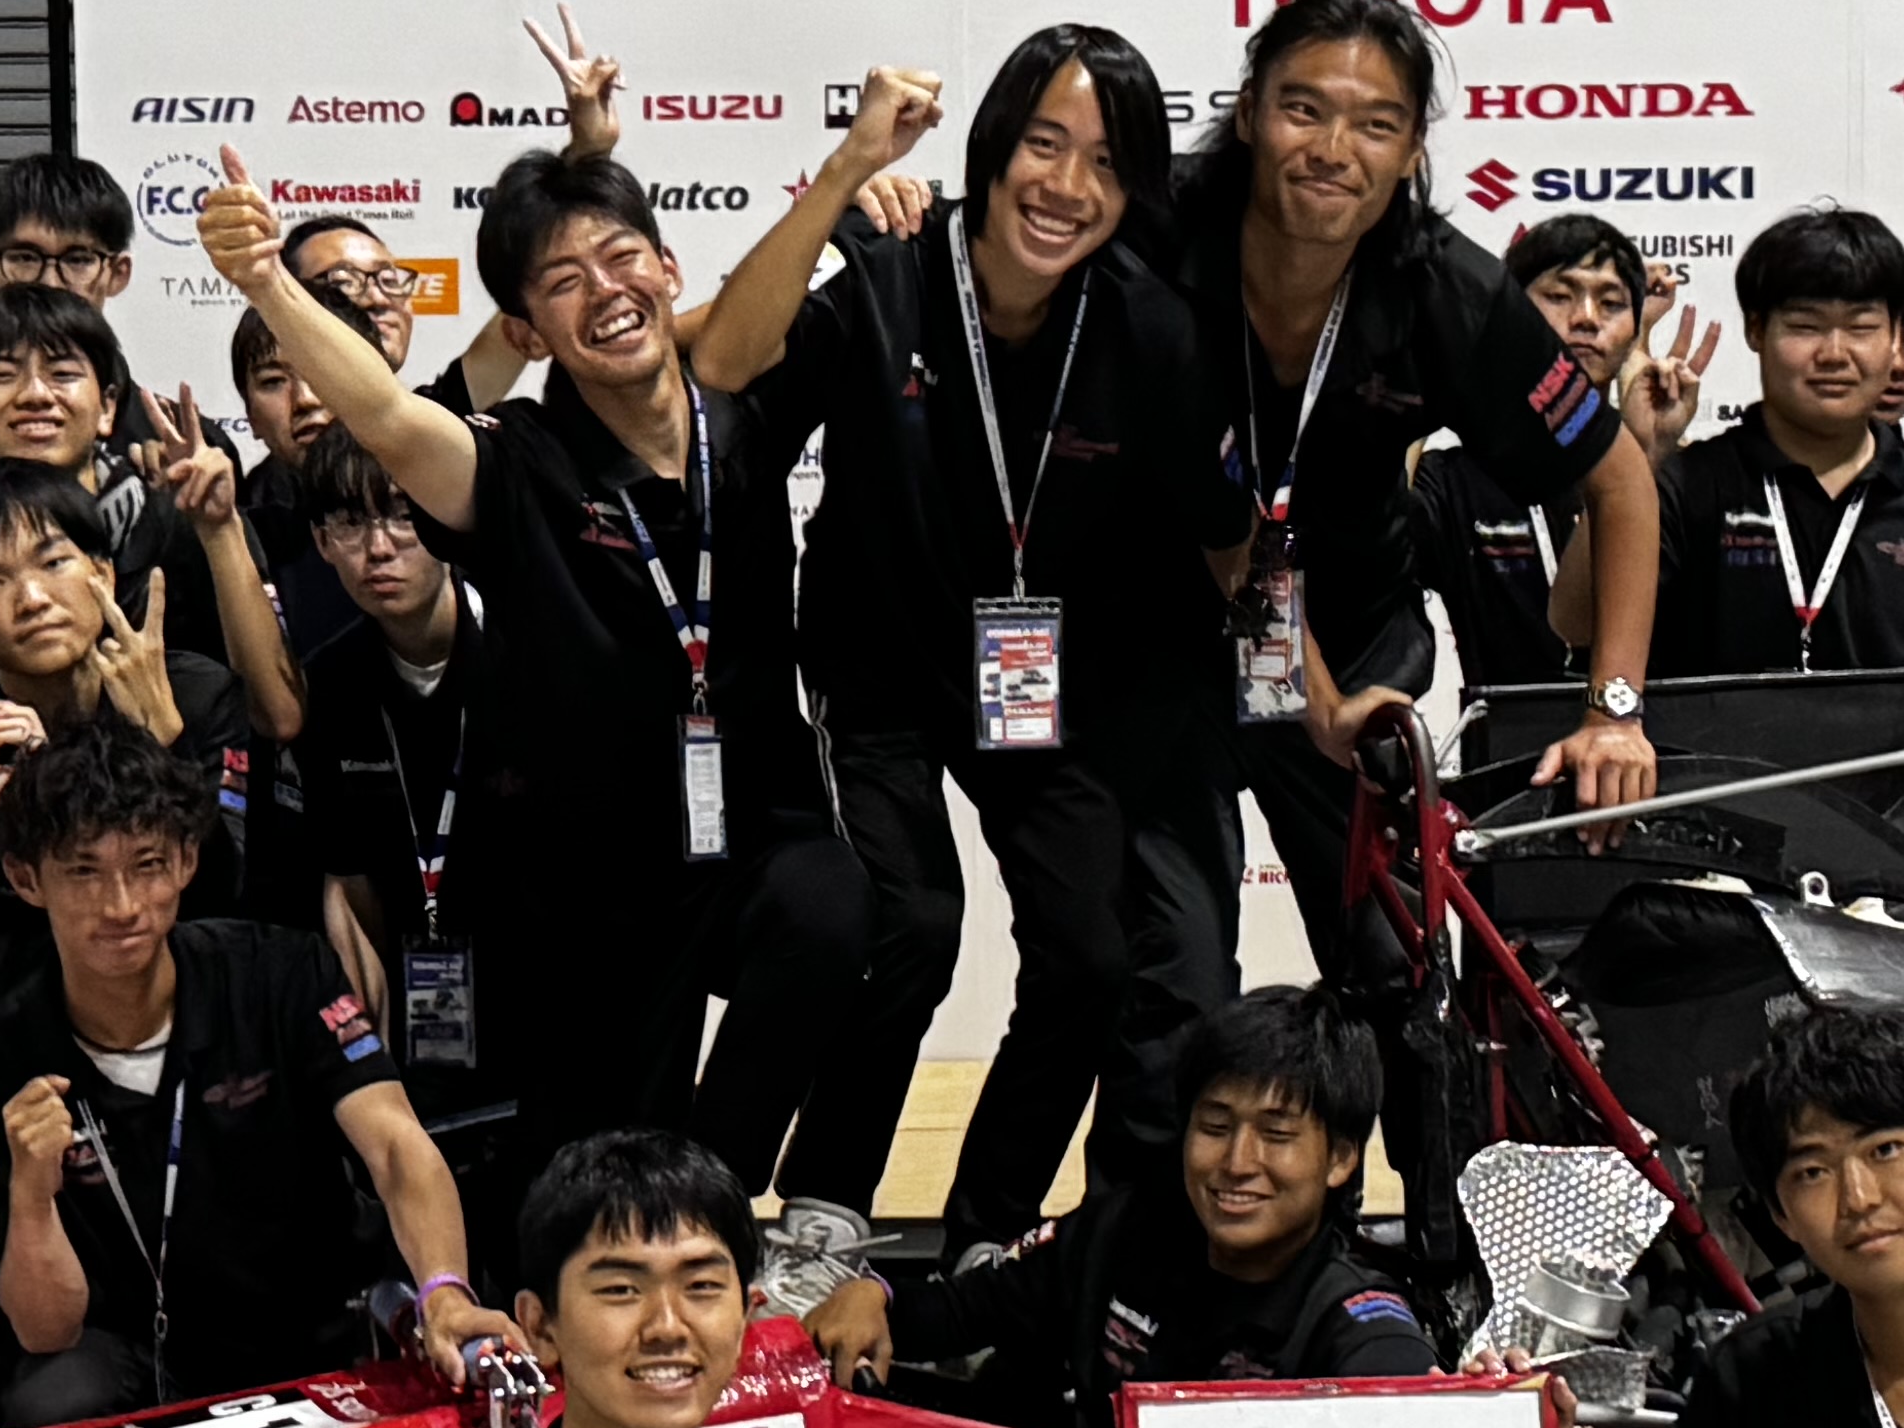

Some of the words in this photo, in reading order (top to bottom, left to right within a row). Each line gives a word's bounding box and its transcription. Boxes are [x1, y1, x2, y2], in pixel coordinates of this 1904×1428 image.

[132, 97, 254, 123] AISIN
[287, 95, 425, 123] Astemo
[450, 91, 571, 127] AMAD
[642, 94, 783, 121] ISUZU
[1464, 82, 1754, 120] HONDA
[271, 179, 422, 204] Kawasaki
[1531, 166, 1755, 202] SUZUKI
